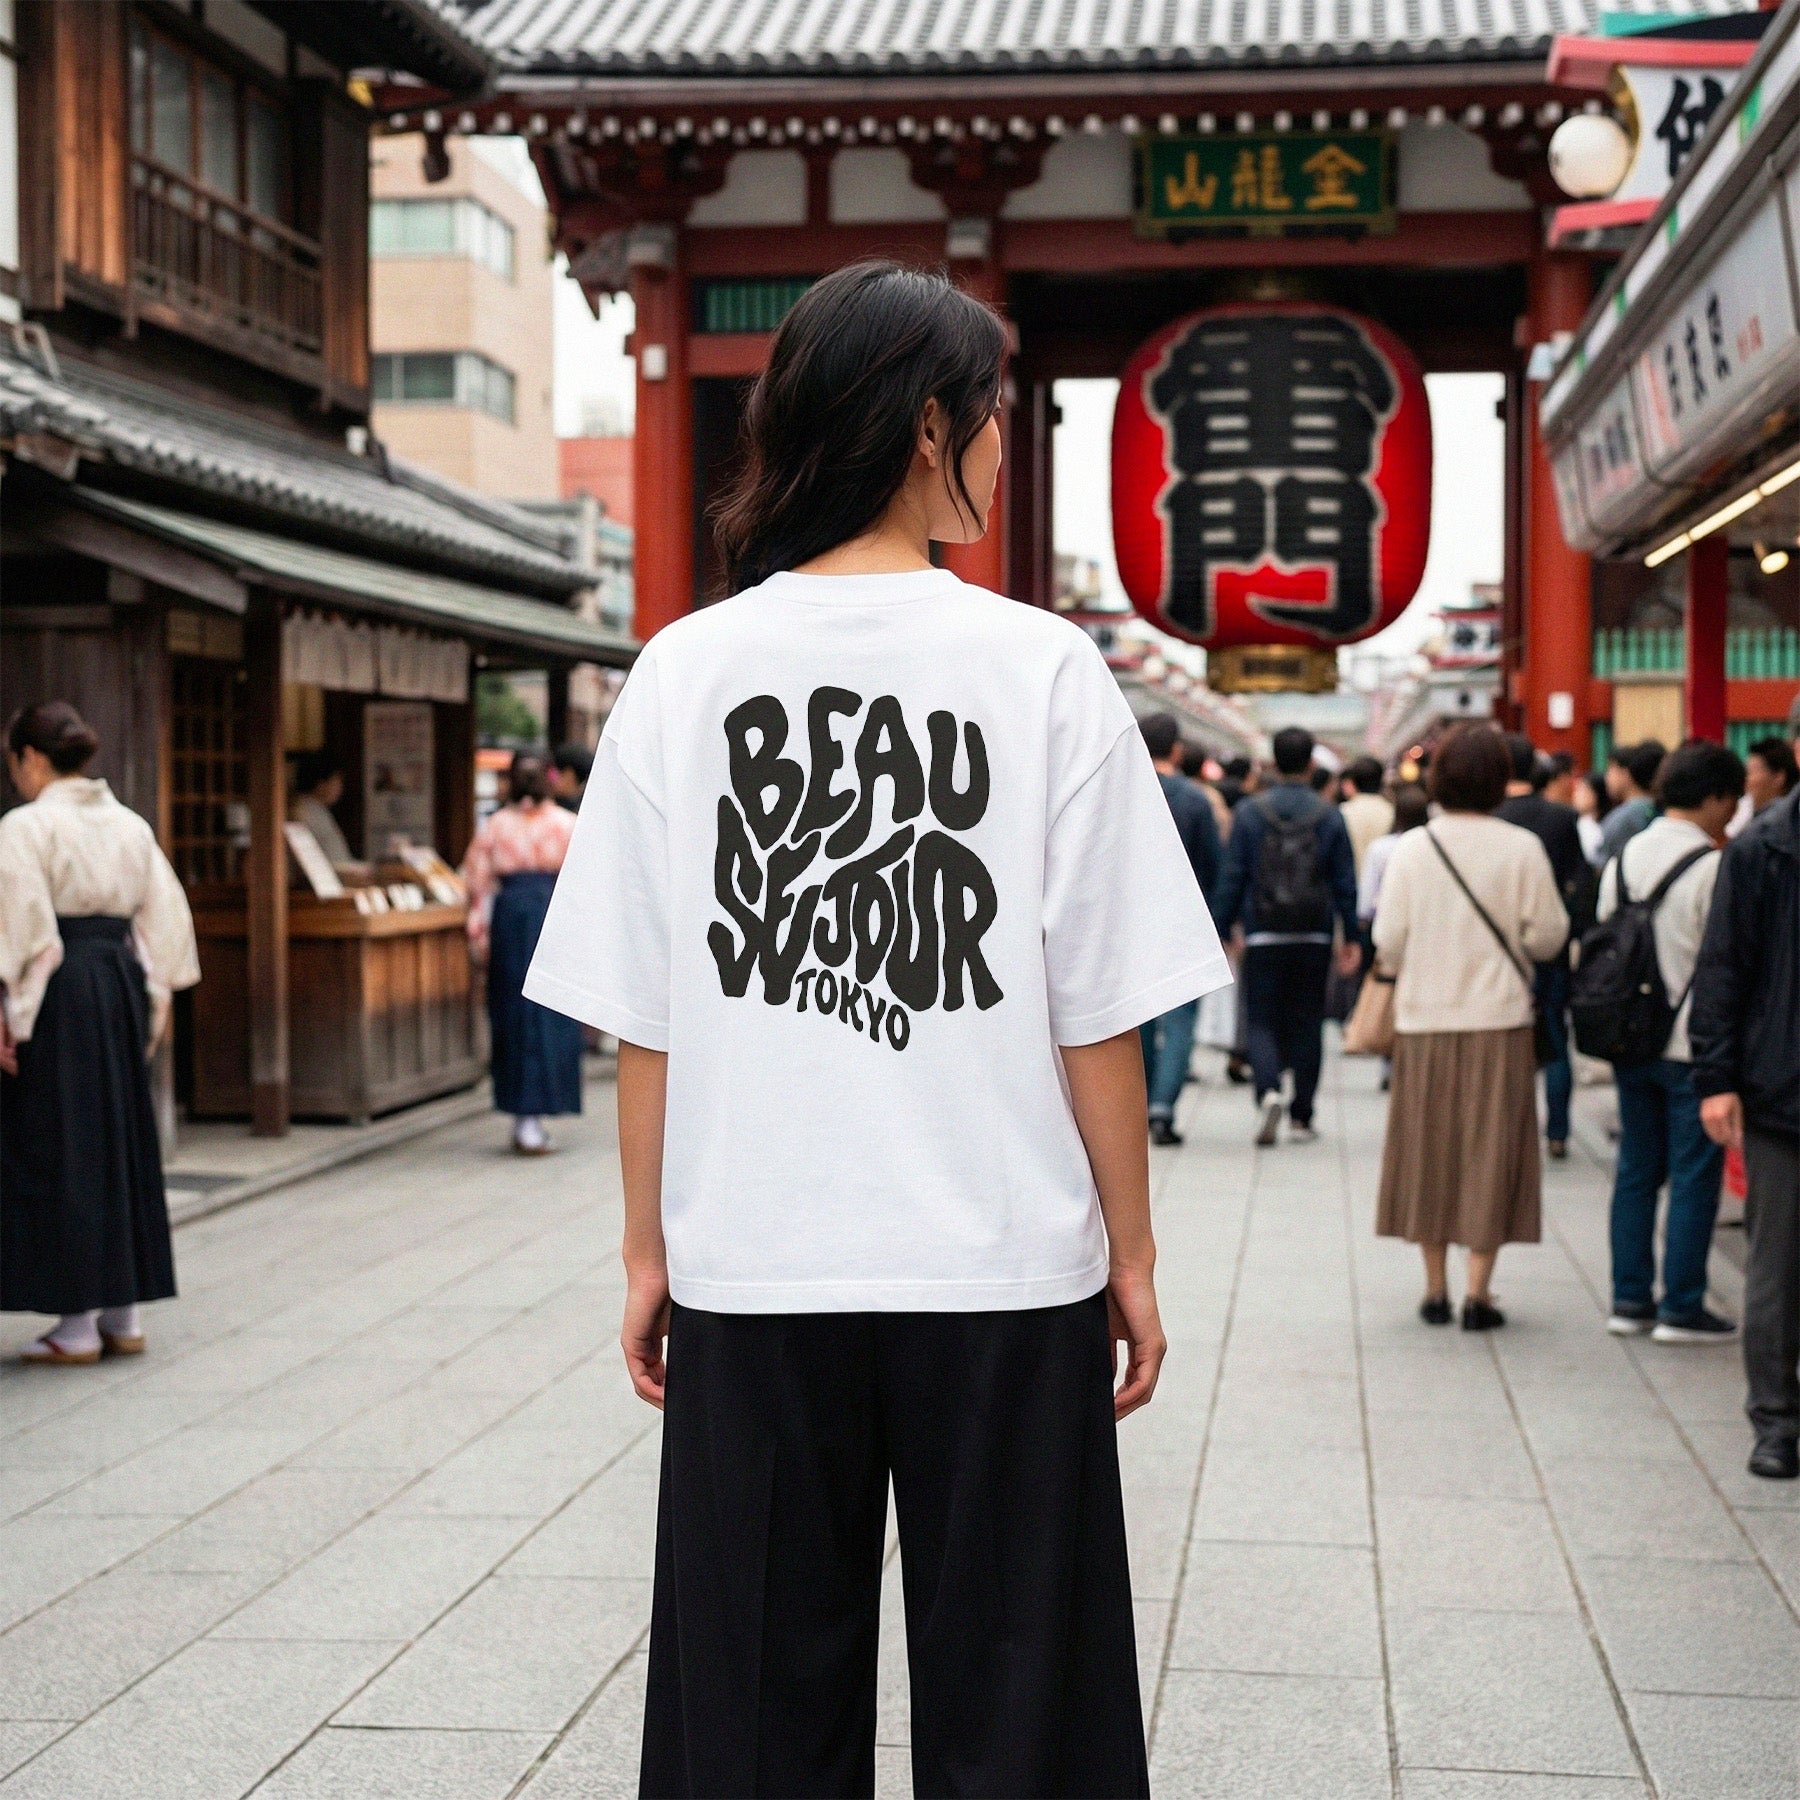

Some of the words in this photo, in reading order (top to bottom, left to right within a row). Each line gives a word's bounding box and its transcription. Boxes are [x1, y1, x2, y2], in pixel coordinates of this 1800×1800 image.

[724, 686, 991, 860] BEAU
[707, 795, 1004, 1013] SEJOUR
[795, 969, 911, 1052] TOKYO
